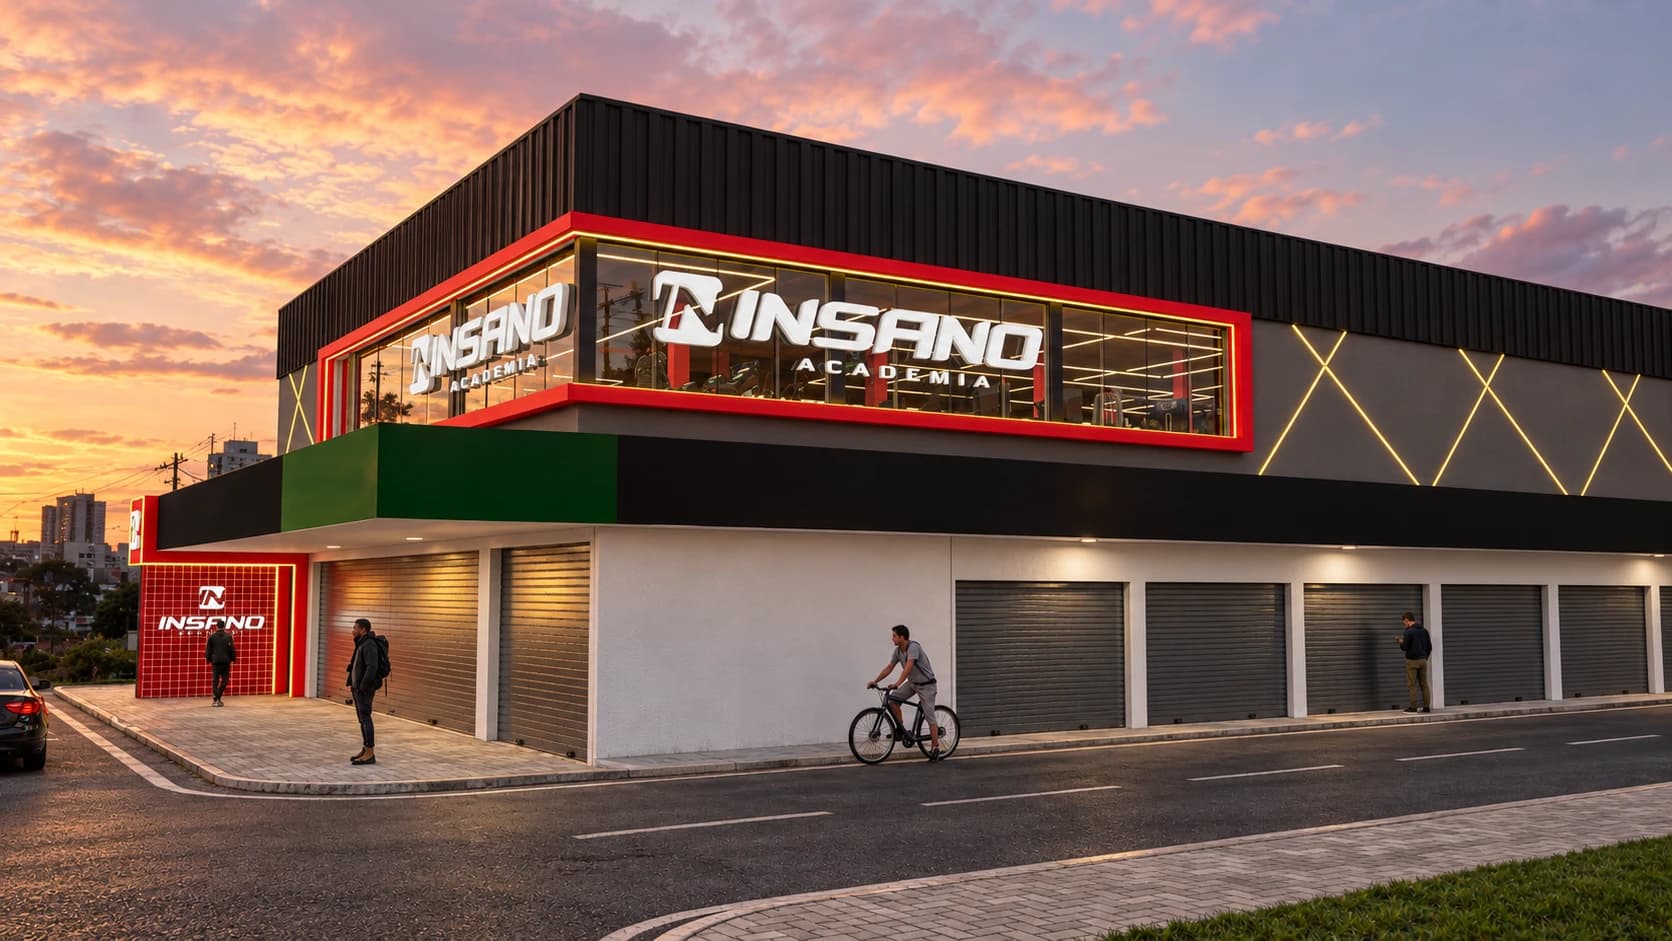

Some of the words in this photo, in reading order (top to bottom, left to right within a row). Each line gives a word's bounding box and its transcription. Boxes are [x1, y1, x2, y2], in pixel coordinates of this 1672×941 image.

[429, 282, 570, 378] INSANO
[730, 289, 1043, 370] INSANO
[450, 353, 538, 393] ACADEMIA
[796, 357, 991, 389] ACADEMIA
